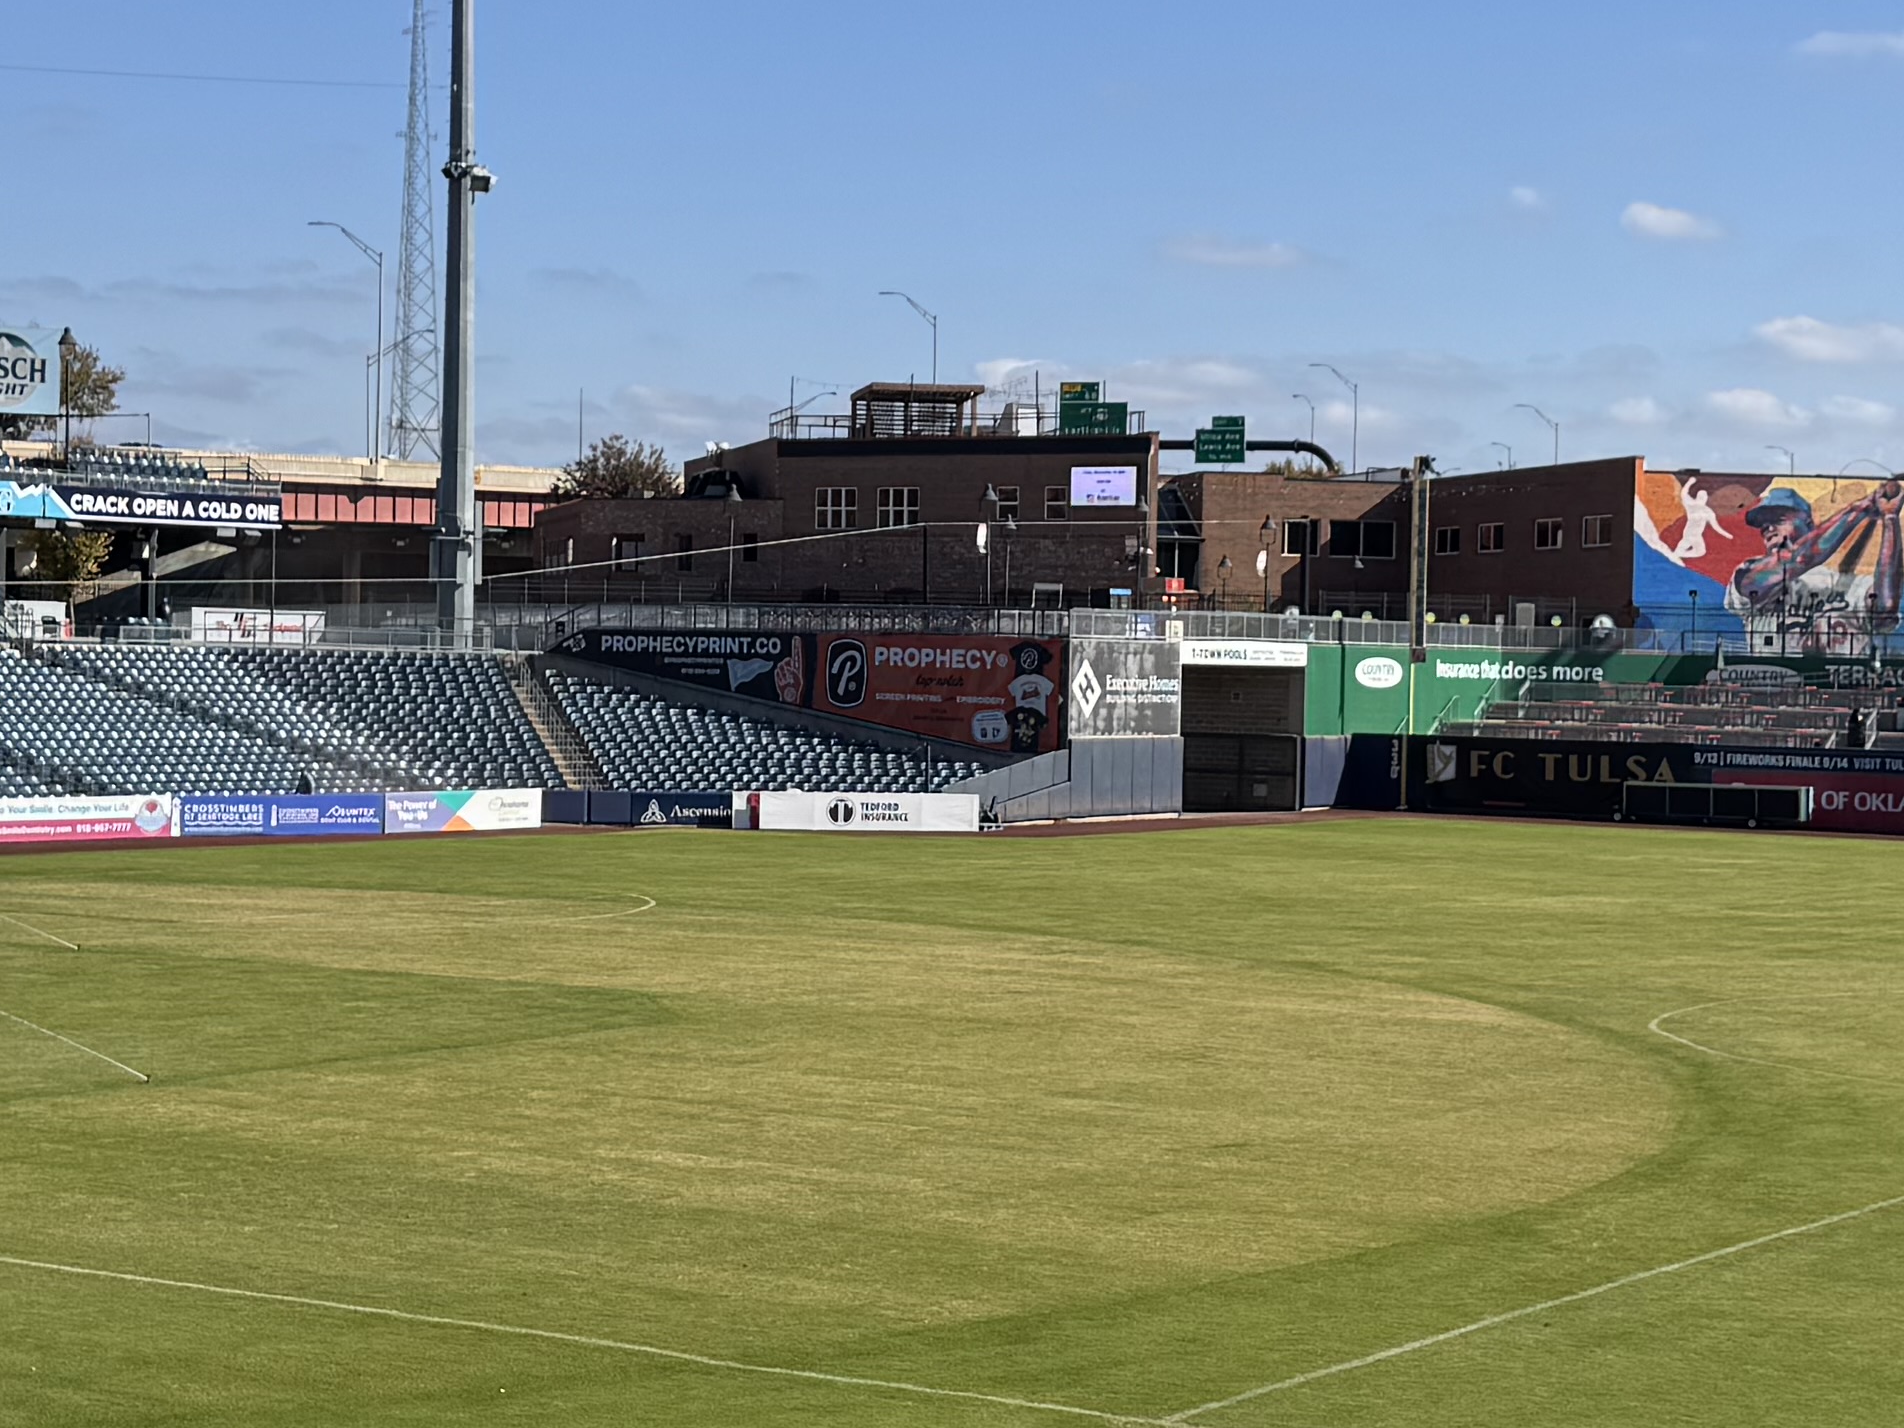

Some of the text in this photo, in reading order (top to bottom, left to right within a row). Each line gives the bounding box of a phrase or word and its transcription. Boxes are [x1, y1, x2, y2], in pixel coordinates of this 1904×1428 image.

[70, 492, 280, 521] CRACK OPEN A COLD ONE
[601, 635, 781, 654] PROPHECYPRINT.CO
[1500, 660, 1547, 680] does
[1552, 663, 1604, 681] more
[1105, 674, 1179, 691] Executive Homes
[1470, 750, 1676, 783] FC TULSA
[1726, 753, 1785, 767] FIREWORKS
[1785, 755, 1821, 769] FINALE
[1853, 757, 1881, 771] VISIT
[7, 805, 29, 815] Your
[57, 803, 89, 816] Change
[93, 803, 112, 813] Your
[113, 802, 130, 812] Life
[860, 802, 900, 812] TEDFORD
[1820, 790, 1850, 811] OF
[860, 812, 909, 822] INSURANCE
